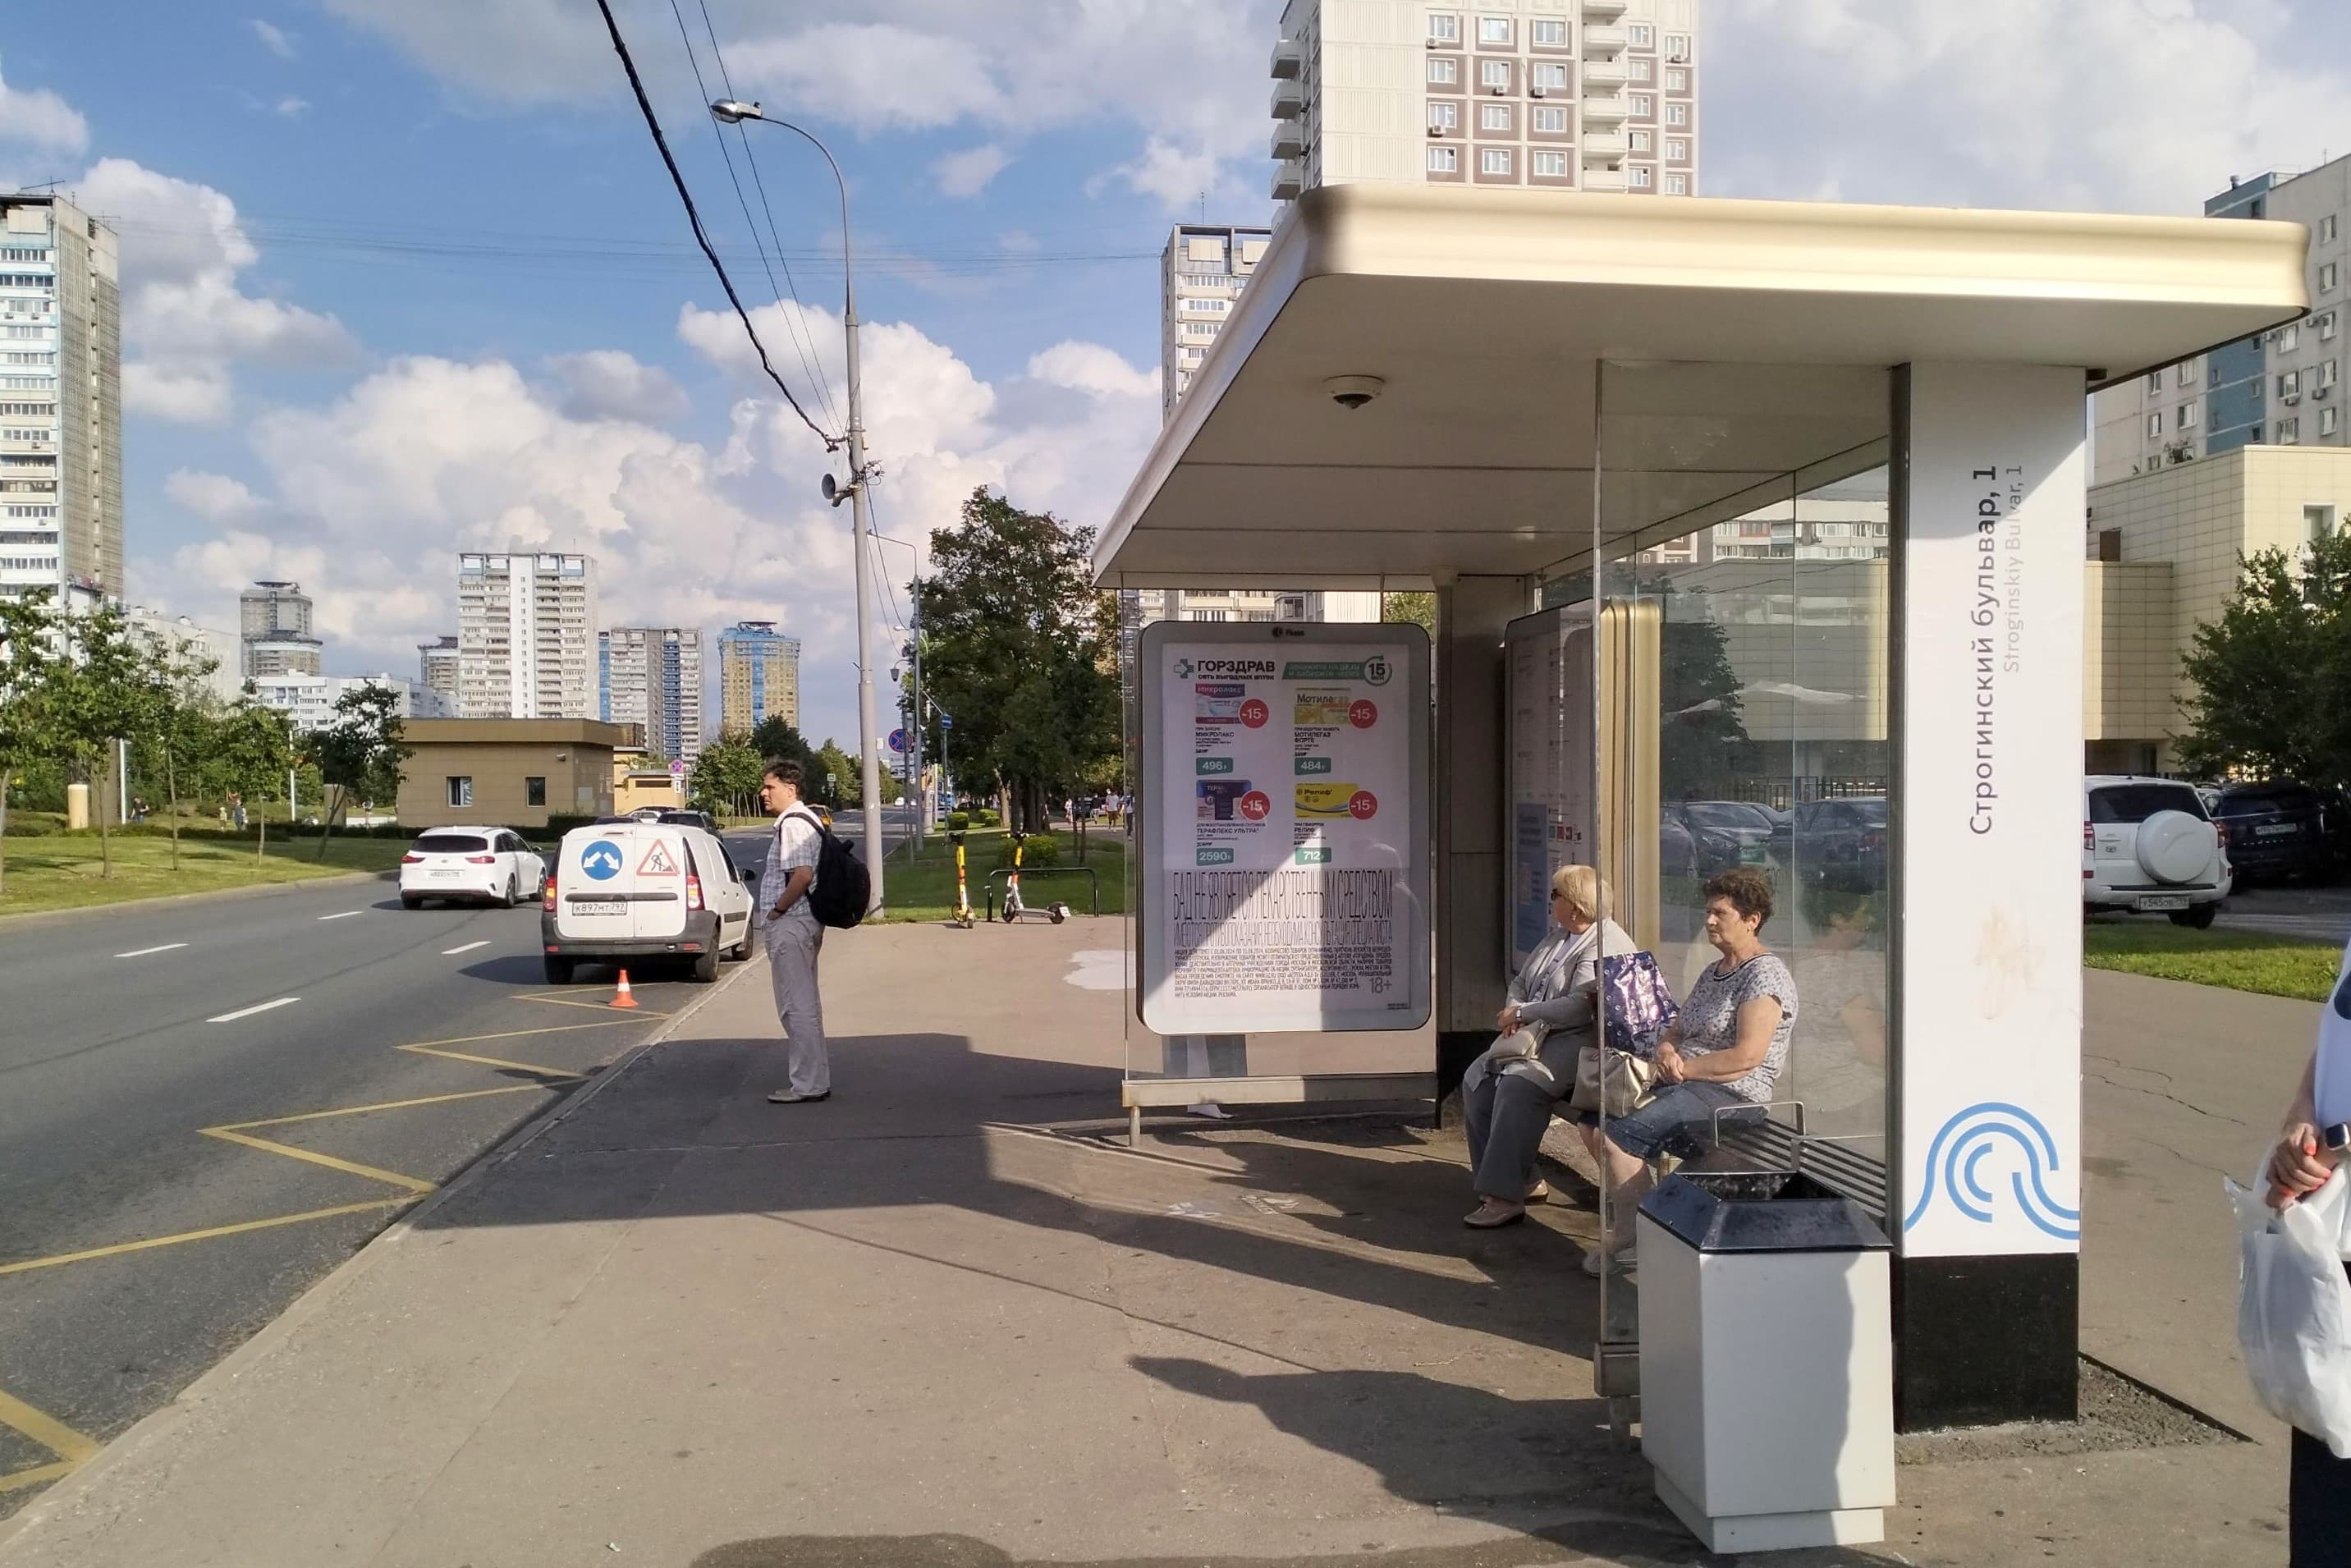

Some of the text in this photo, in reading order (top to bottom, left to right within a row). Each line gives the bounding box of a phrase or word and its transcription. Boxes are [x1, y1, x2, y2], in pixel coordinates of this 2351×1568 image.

[2006, 465, 2022, 475] 1
[2004, 554, 2024, 673] Stroginskiy
[1970, 465, 2001, 835] Строгинский бульвар, 1
[1198, 660, 1276, 673] ГОРЗДРАВ
[1368, 663, 1386, 676] 15
[1369, 977, 1393, 994] 18+
